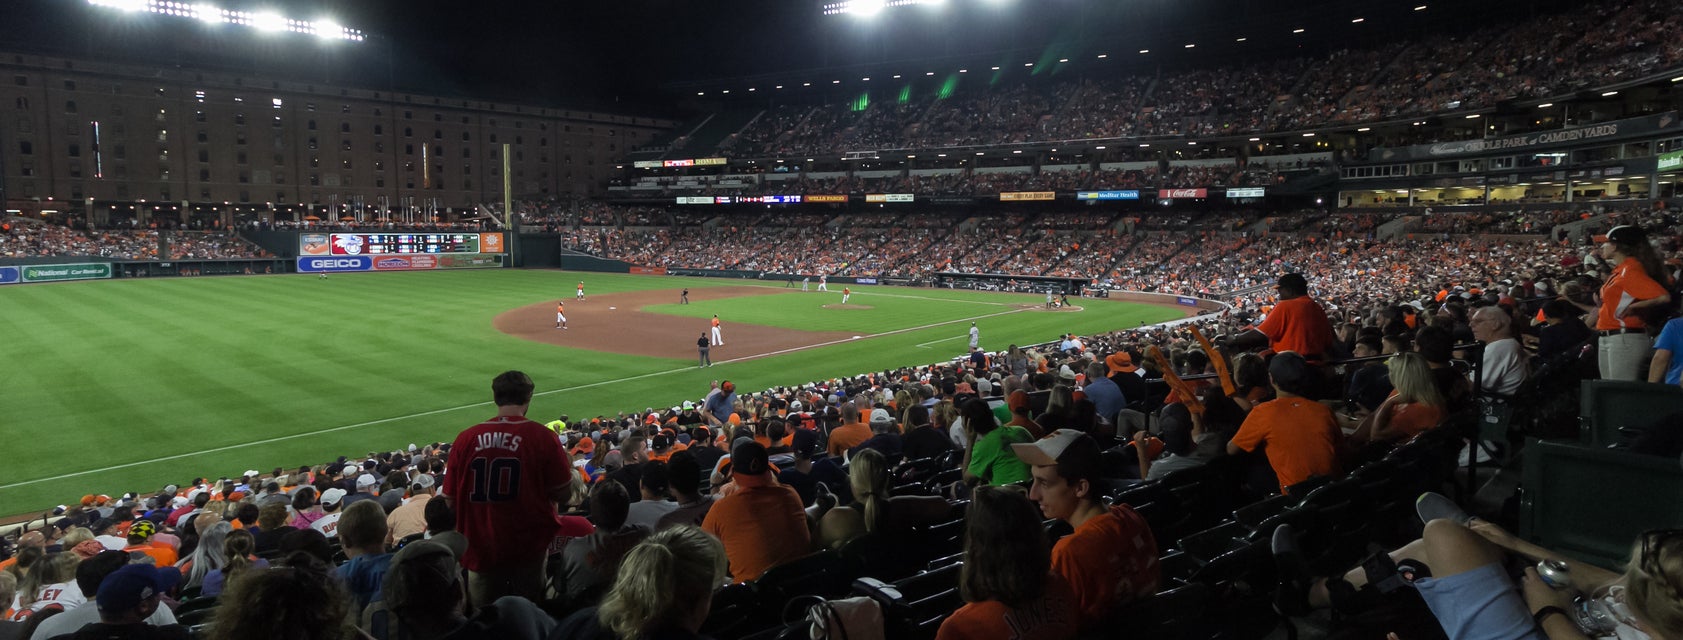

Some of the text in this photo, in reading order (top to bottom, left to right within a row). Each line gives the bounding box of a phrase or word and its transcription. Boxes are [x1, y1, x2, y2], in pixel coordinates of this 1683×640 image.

[1465, 139, 1502, 152] ORIOLE
[1503, 136, 1529, 149] PARK
[1538, 129, 1583, 144] CAMDEN
[1584, 124, 1617, 138] YARDS
[38, 269, 68, 277] National
[311, 259, 361, 268] GEICO
[475, 431, 522, 452] JONES
[470, 456, 521, 503] 10
